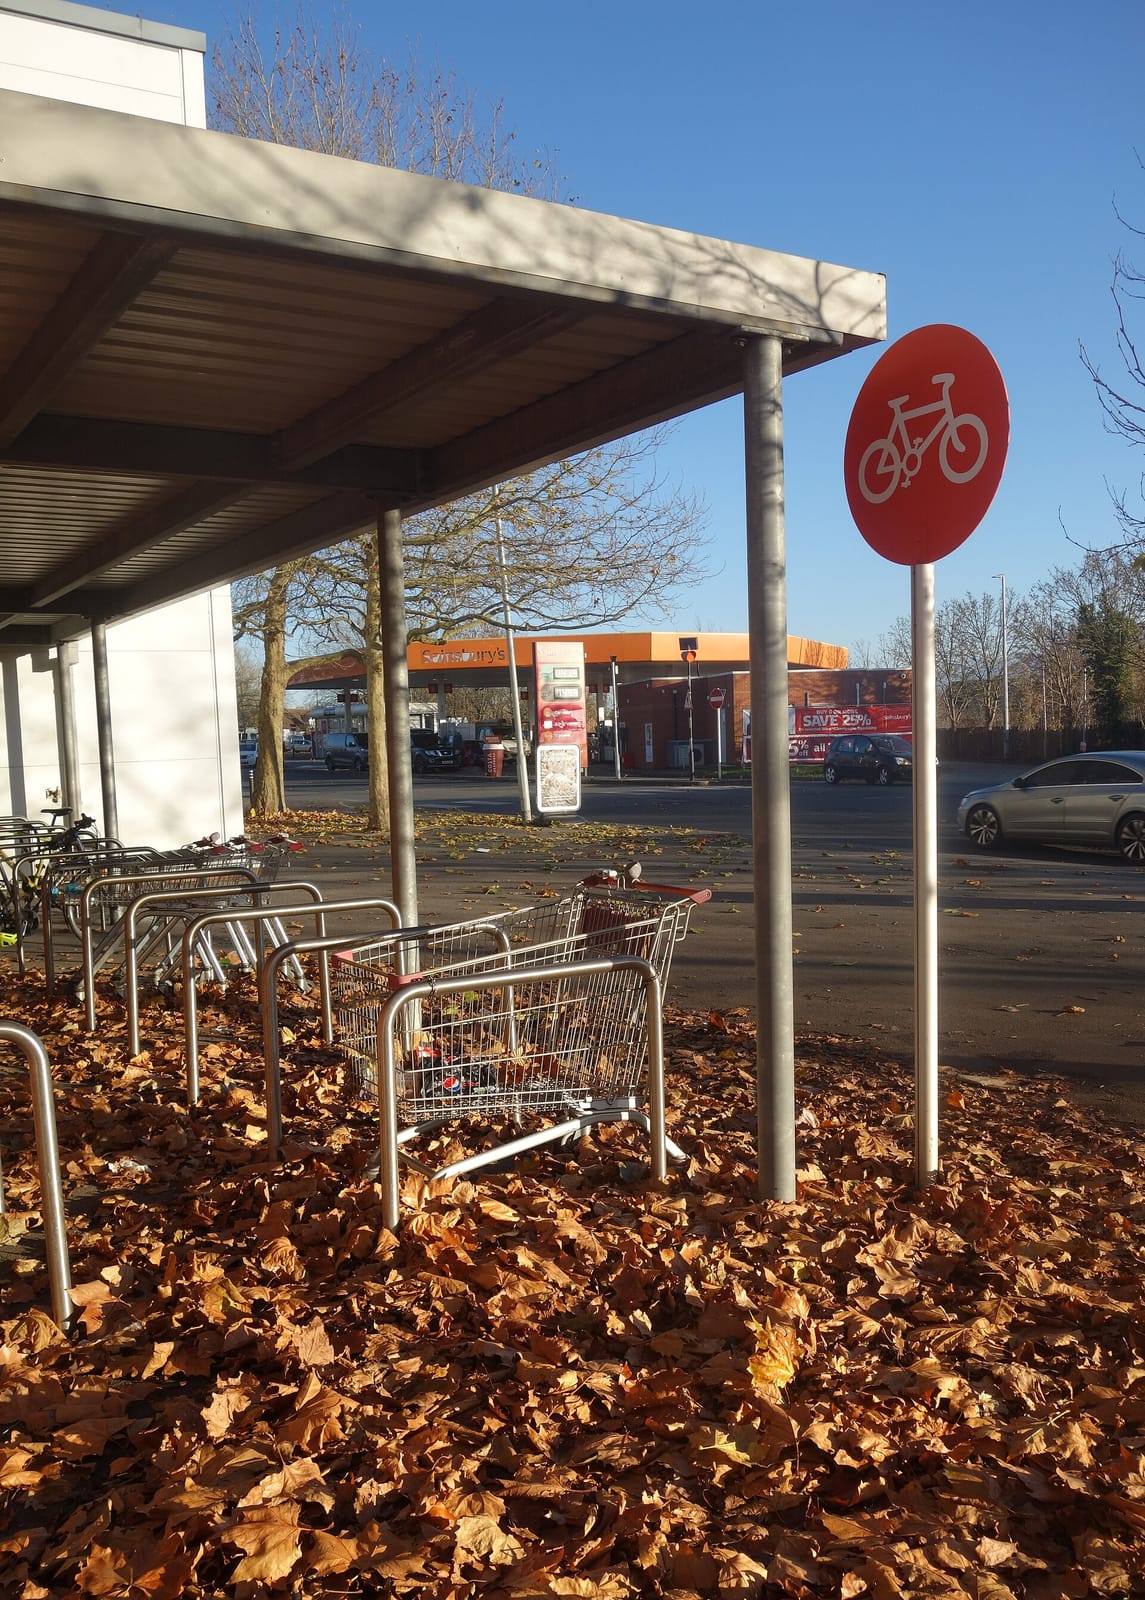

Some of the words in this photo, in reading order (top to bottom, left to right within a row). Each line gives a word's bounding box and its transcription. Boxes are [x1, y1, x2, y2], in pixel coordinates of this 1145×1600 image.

[422, 647, 505, 664] Sainsbury's
[803, 715, 839, 727] SAVE
[842, 714, 872, 726] 25%
[813, 743, 826, 753] all
